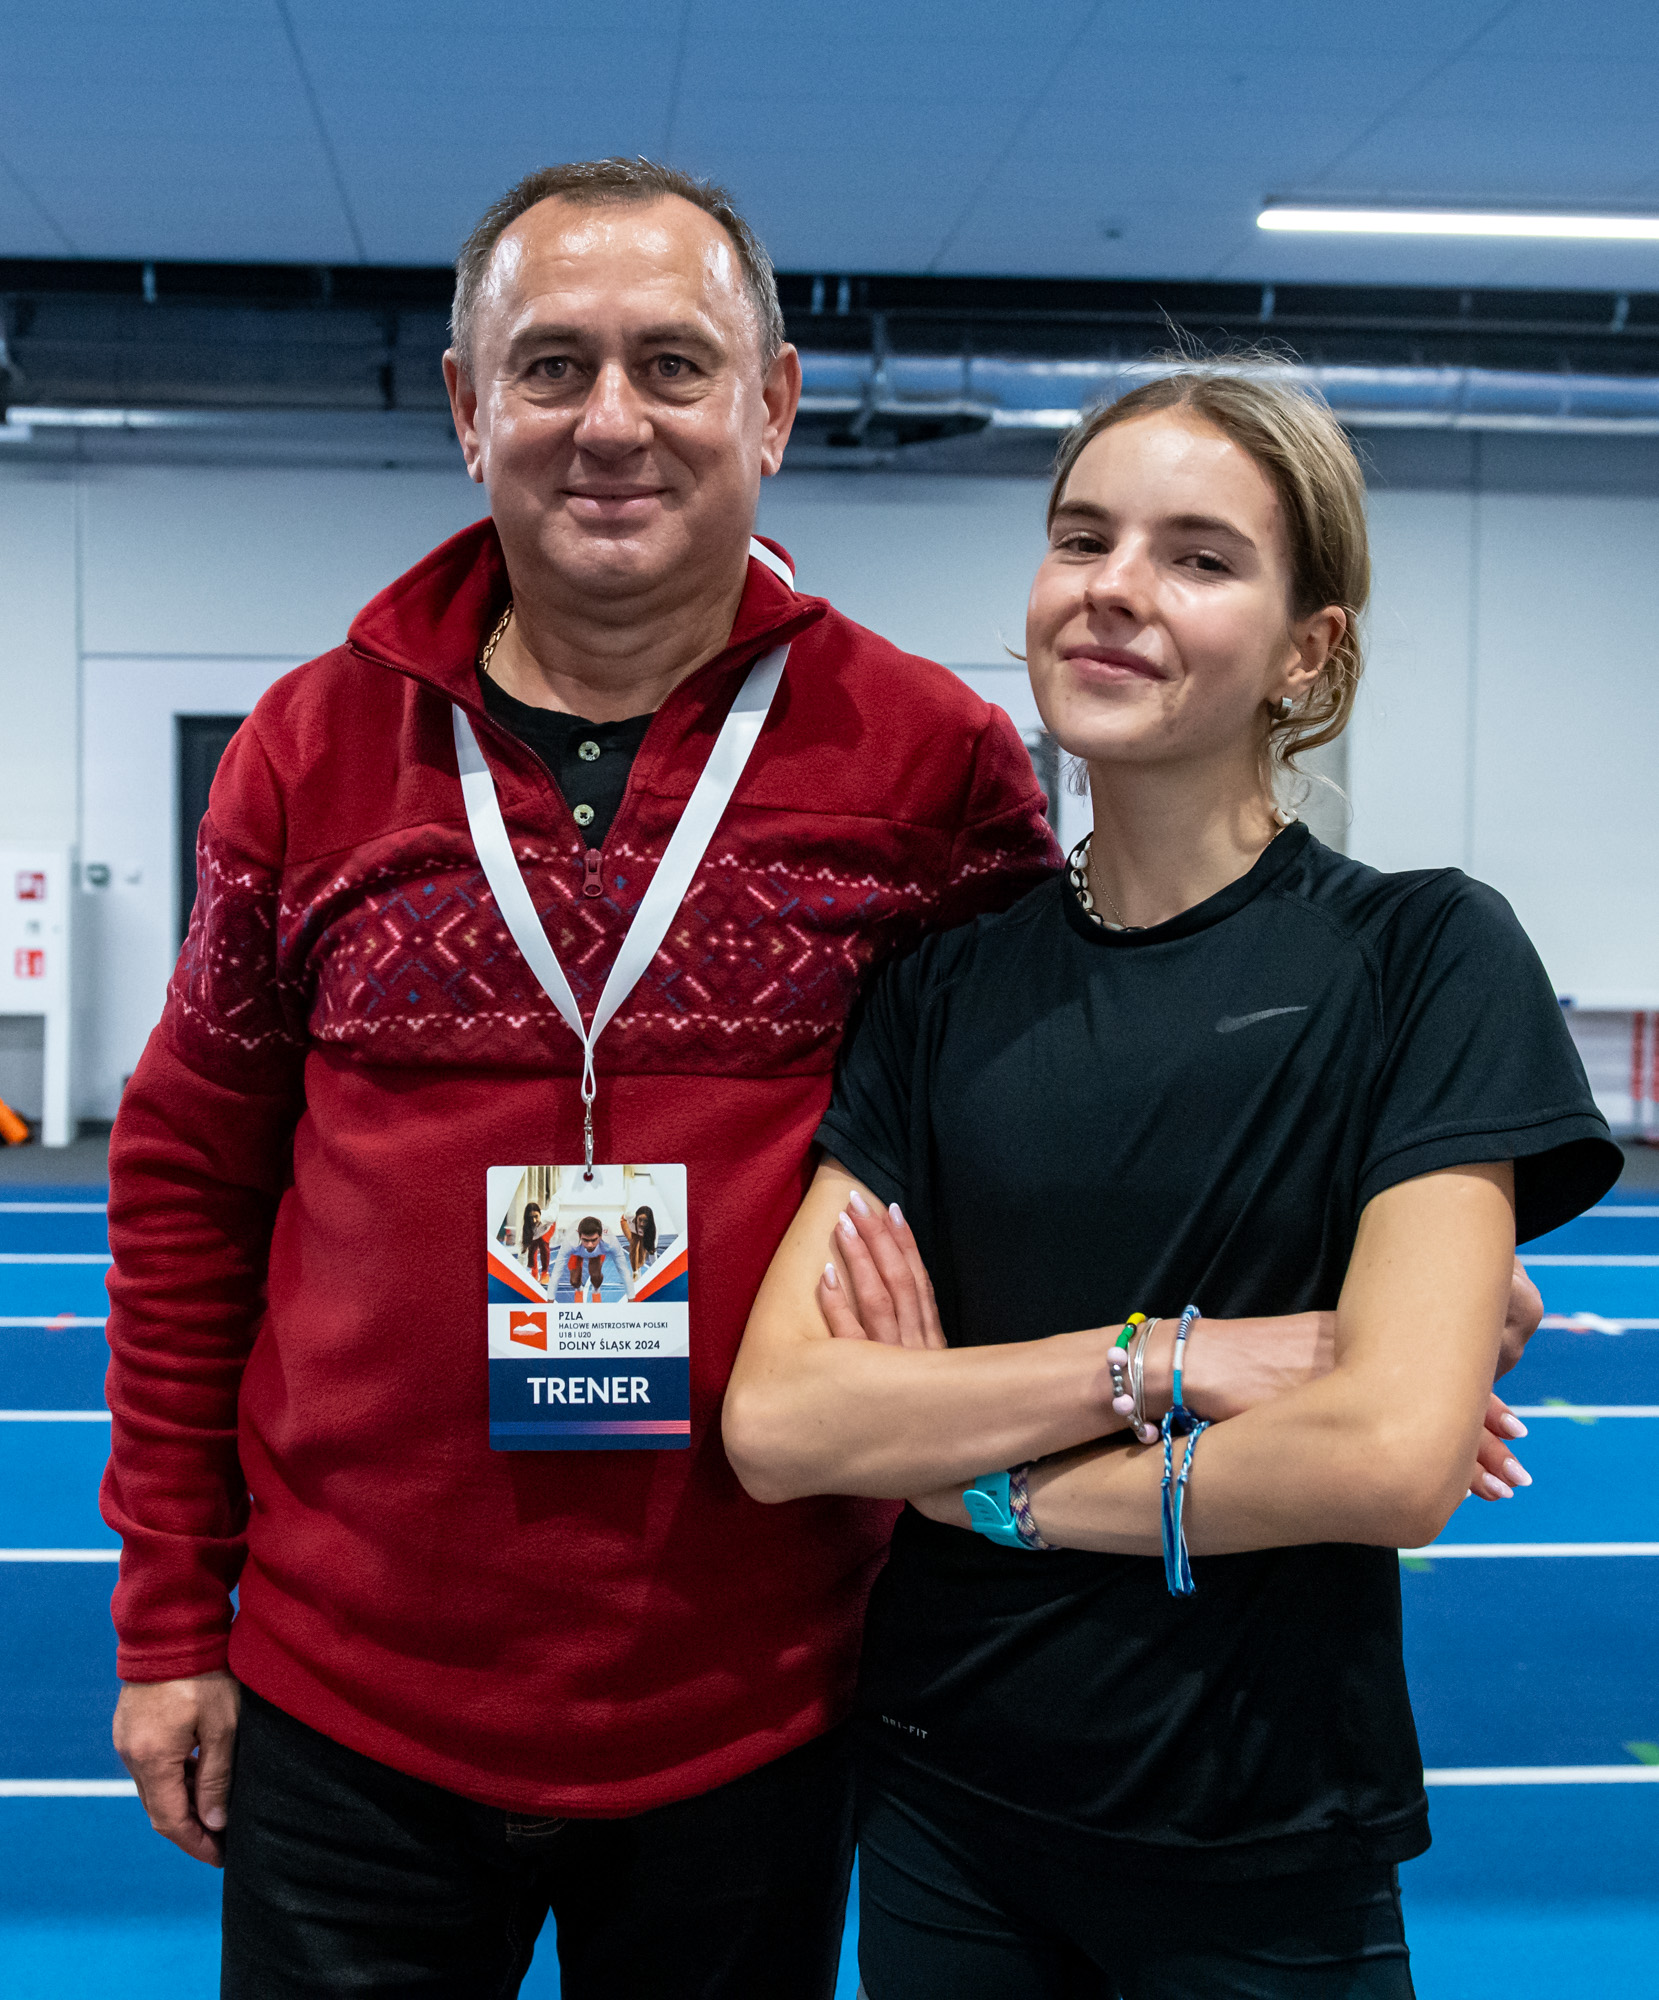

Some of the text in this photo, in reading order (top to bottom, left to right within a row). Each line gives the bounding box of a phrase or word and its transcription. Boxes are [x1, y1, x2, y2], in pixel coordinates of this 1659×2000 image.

[558, 1311, 584, 1321] PZLA
[558, 1322, 590, 1330] HALOWE
[643, 1321, 668, 1329] POLSKI
[559, 1338, 661, 1352] DOLNY ŚLĄSK 2024
[526, 1376, 651, 1405] TRENER
